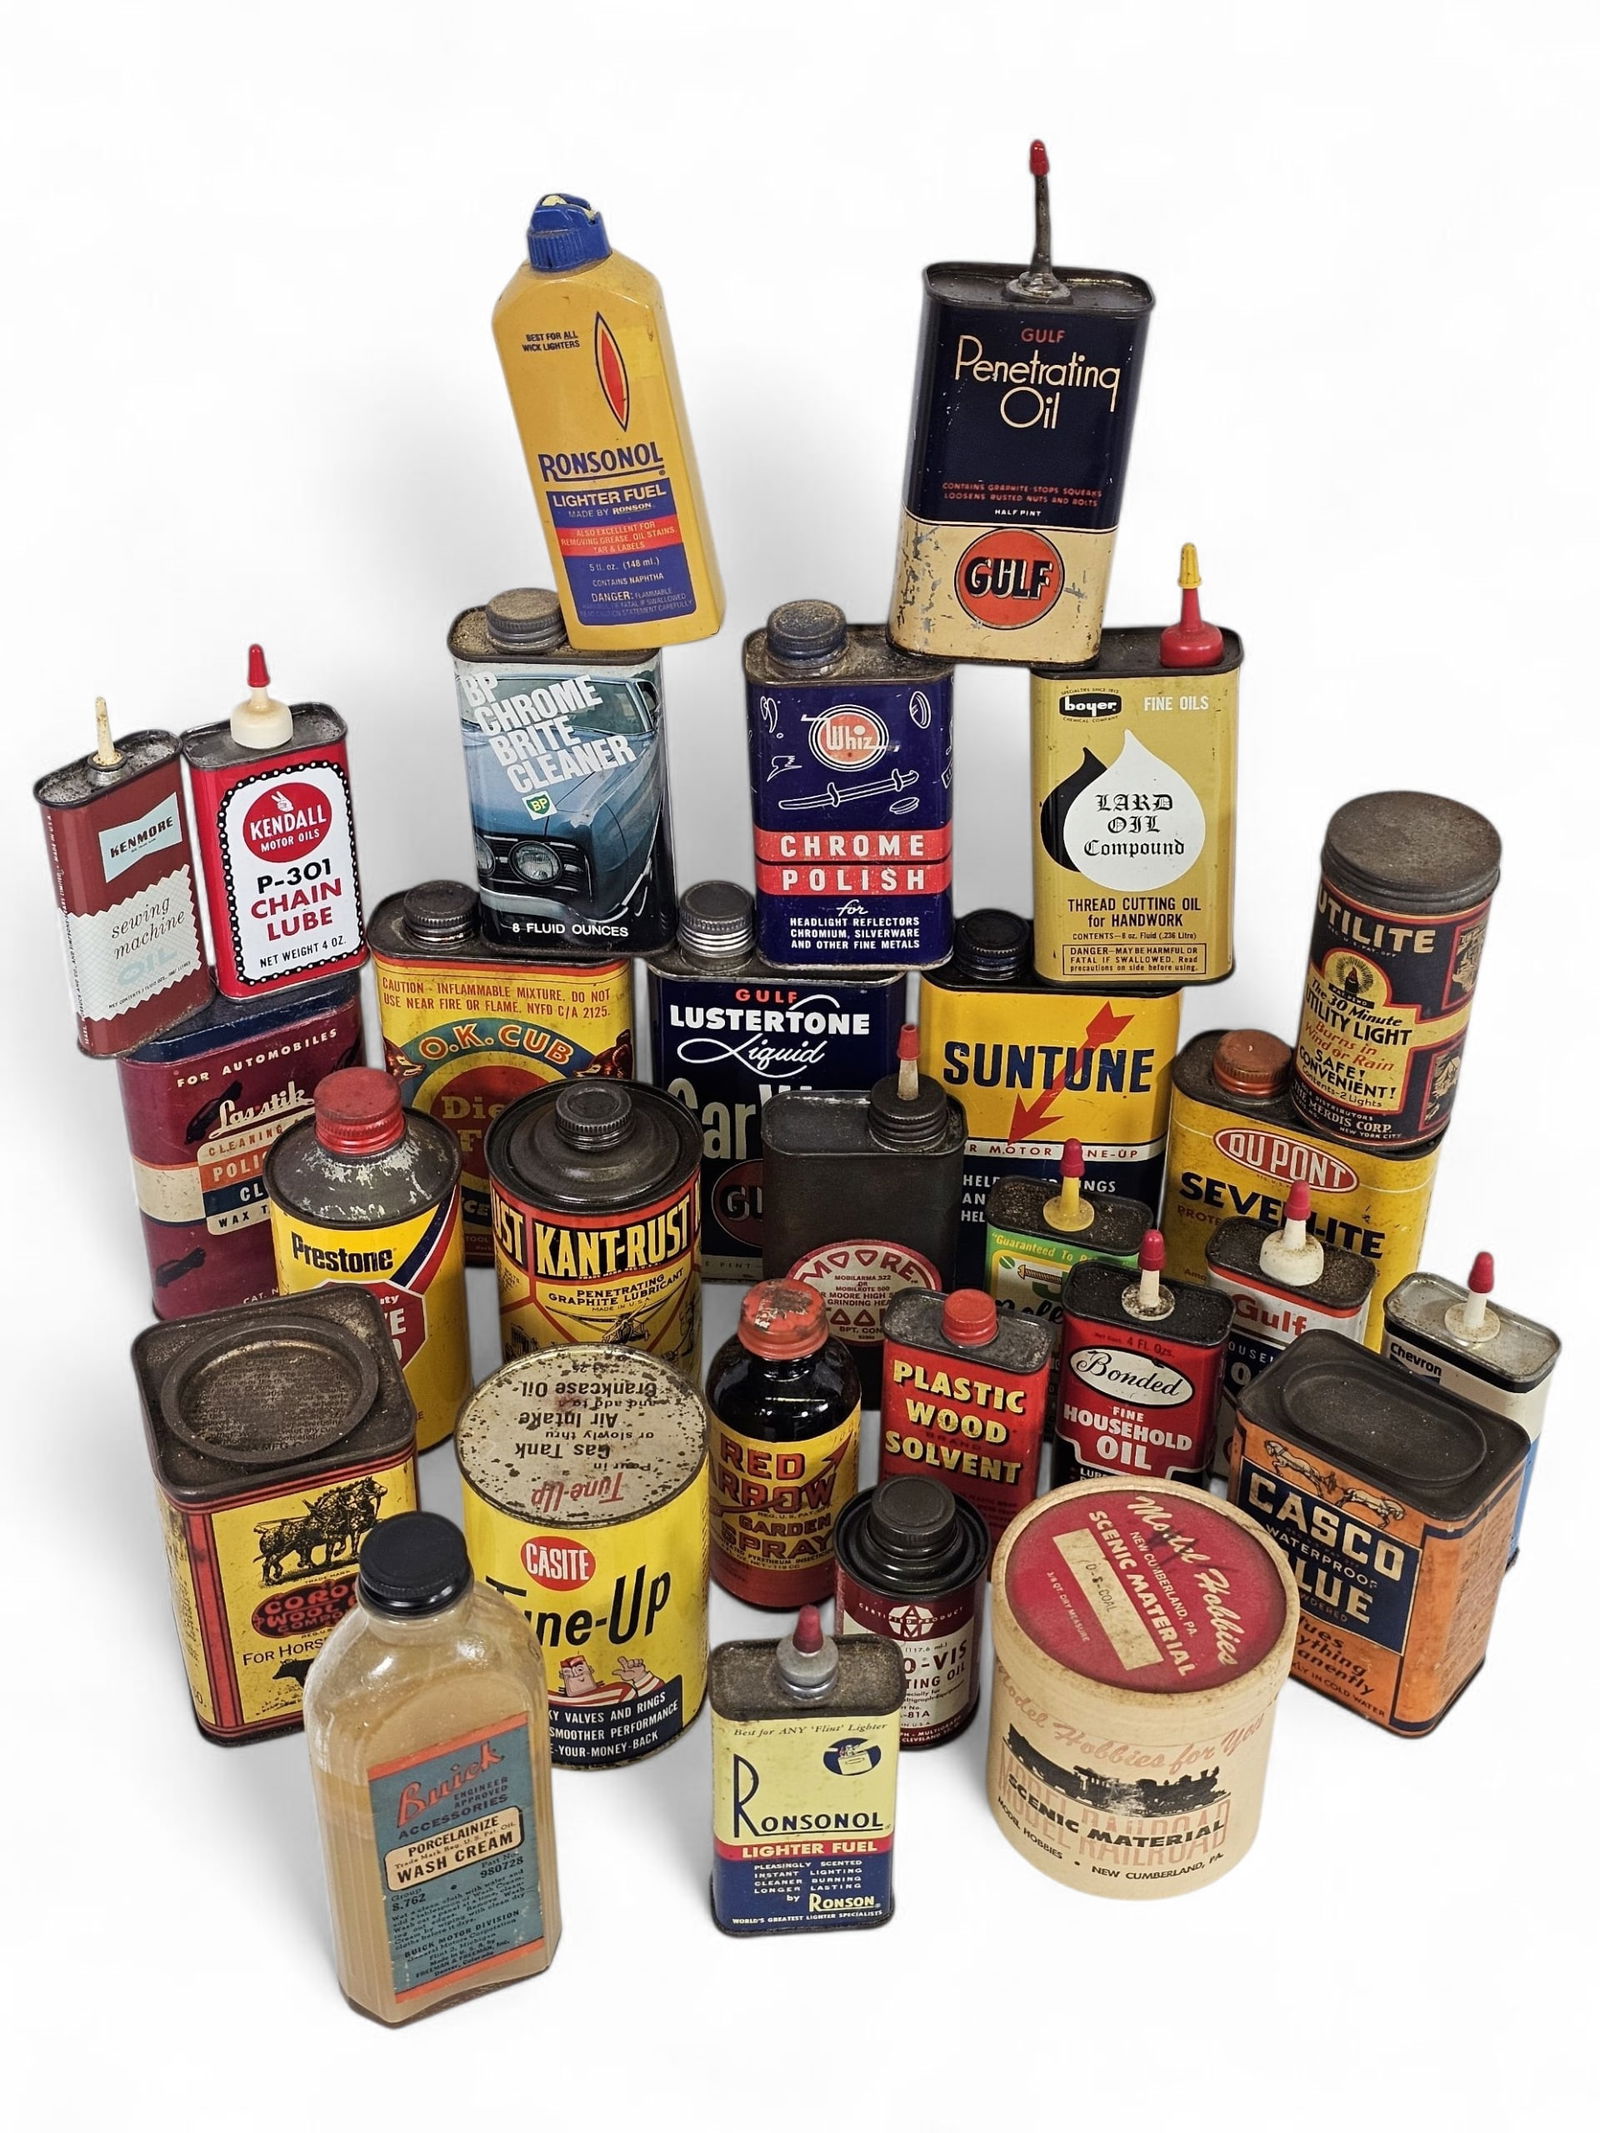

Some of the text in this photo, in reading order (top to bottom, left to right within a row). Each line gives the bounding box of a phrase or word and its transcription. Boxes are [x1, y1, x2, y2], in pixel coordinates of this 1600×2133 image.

[522, 342, 541, 353] WICK
[525, 330, 578, 342] BEST FOR ALL
[1020, 328, 1065, 343] GULF
[1000, 386, 1060, 429] Oil
[538, 441, 664, 482] RONSONOL
[553, 484, 667, 508] LIGHTER FUEL
[569, 503, 651, 518] MADE BY RONSON
[1020, 509, 1042, 517] PINT
[630, 573, 664, 585] NAPHTHA
[964, 555, 1053, 601] GULF
[591, 592, 634, 603] DANGER:
[457, 671, 498, 708] BP
[474, 674, 603, 737] CHROME
[1064, 696, 1209, 717] boyer FINE OILS
[488, 715, 582, 767] BRITE
[506, 735, 637, 794] CLEANER
[1095, 794, 1173, 812] LARD
[110, 815, 174, 859] KENMORE
[250, 805, 327, 841] KENDALL
[1107, 816, 1160, 834] OIL
[260, 828, 320, 853] MOTOR OILS
[780, 835, 924, 857] CHROME
[257, 858, 331, 894] P-301
[783, 868, 924, 891] POLISH
[250, 878, 342, 919] CHAIN
[1068, 897, 1202, 912] THREAD CUTTING OIL
[111, 896, 170, 940] sewing
[266, 907, 333, 942] LUBE
[512, 923, 629, 937] 8 FLUID OUNCES
[790, 916, 919, 927] HEADLIGHT REFLECTORS
[854, 928, 920, 937] SILVERWARE
[1088, 913, 1184, 928] for HANDWORK
[1319, 890, 1436, 955] UTILITE
[114, 910, 185, 960] machine
[282, 939, 328, 962] WEIGHT 4
[791, 939, 920, 949] AND OTHER FINE METALS
[1147, 947, 1185, 955] HARMFUL
[1070, 956, 1097, 964] FATAL
[1149, 964, 1172, 972] before
[382, 976, 611, 1003] CAUTION INFLAMMABLE DO NOT
[406, 997, 480, 1011] NEAR FIRE OR
[735, 988, 798, 1004] GULF
[670, 1003, 870, 1036] LUSTERTONE
[1350, 1004, 1403, 1027] Minute
[419, 1023, 575, 1065] O.K. CUB
[1353, 1020, 1413, 1050] LIGHT
[177, 1028, 337, 1088] FOR AUTOMOBILES
[677, 1033, 828, 1078] Liquid
[943, 1040, 1155, 1093] SUNTUNE
[1315, 1047, 1366, 1081] SAFE!
[1350, 1093, 1383, 1108] Lights
[1310, 1102, 1393, 1135] MERDIS CORP.
[1340, 1127, 1356, 1137] NEW
[208, 1124, 282, 1157] CLEANING
[1269, 1138, 1347, 1189] PONT
[291, 1231, 394, 1274] Prestone
[535, 1193, 691, 1279] KANT-RUST
[799, 1249, 919, 1283] MOORE
[548, 1292, 619, 1307] GRAPHITE
[624, 1268, 684, 1303] LUBRICANT
[576, 1273, 666, 1298] PENETRATING
[827, 1299, 876, 1307] GRINDING
[1232, 1292, 1308, 1338] Gulf
[1076, 1350, 1184, 1398] Bonded
[1389, 1341, 1442, 1377] Chevron
[555, 1381, 659, 1398] Crankcase
[893, 1359, 1026, 1415] PLASTIC
[519, 1411, 581, 1430] Intake
[906, 1398, 1009, 1444] WOOD
[1063, 1403, 1194, 1452] HOUSEHOLD
[1112, 1405, 1145, 1424] FINE
[514, 1443, 563, 1459] Tank
[545, 1431, 634, 1442] slowly thru
[1096, 1434, 1153, 1472] OIL
[720, 1432, 806, 1481] RED
[885, 1429, 1023, 1484] SOLVENT
[530, 1471, 625, 1514] Tune-Up
[721, 1519, 834, 1560] SPRAY
[738, 1513, 832, 1538] GARDEN
[1248, 1472, 1405, 1582] CASCO
[1266, 1526, 1378, 1590] WATERPROOF
[1088, 1510, 1138, 1573] SCENIC
[1126, 1572, 1198, 1680] MATERIAL
[1193, 1567, 1246, 1668] Hobbies
[564, 1692, 666, 1724] VALVES AND RINGS
[1324, 1678, 1386, 1718] COLD WATER
[549, 1700, 679, 1741] SMOOTHER PERFORMANCE
[734, 1726, 805, 1739] Best for ANY
[1054, 1722, 1166, 1771] Hobbies
[454, 1777, 508, 1801] ENGINEER
[734, 1753, 884, 1840] RONSONOL
[398, 1794, 509, 1841] ACCESSORIES
[1008, 1774, 1226, 1848] SCENIC MATERIAL
[408, 1815, 499, 1857] PORCELAINIZE
[742, 1841, 878, 1860] LIGHTER FUEL
[397, 1831, 514, 1884] WASH CREAM
[480, 1855, 525, 1880] 980728
[754, 1859, 862, 1871] PLEASINGLY SCENTED
[754, 1868, 862, 1879] INSTANT LIGHTING
[1092, 1865, 1121, 1879] NEW
[754, 1876, 862, 1887] CLEANER BURNING
[754, 1883, 862, 1895] LONGER LASTING
[767, 1910, 883, 1923] GREATEST LIGHTER SPECIALISTS
[786, 1892, 876, 1913] by RONSON
[438, 1909, 520, 1946] MOTOR DIVISION
